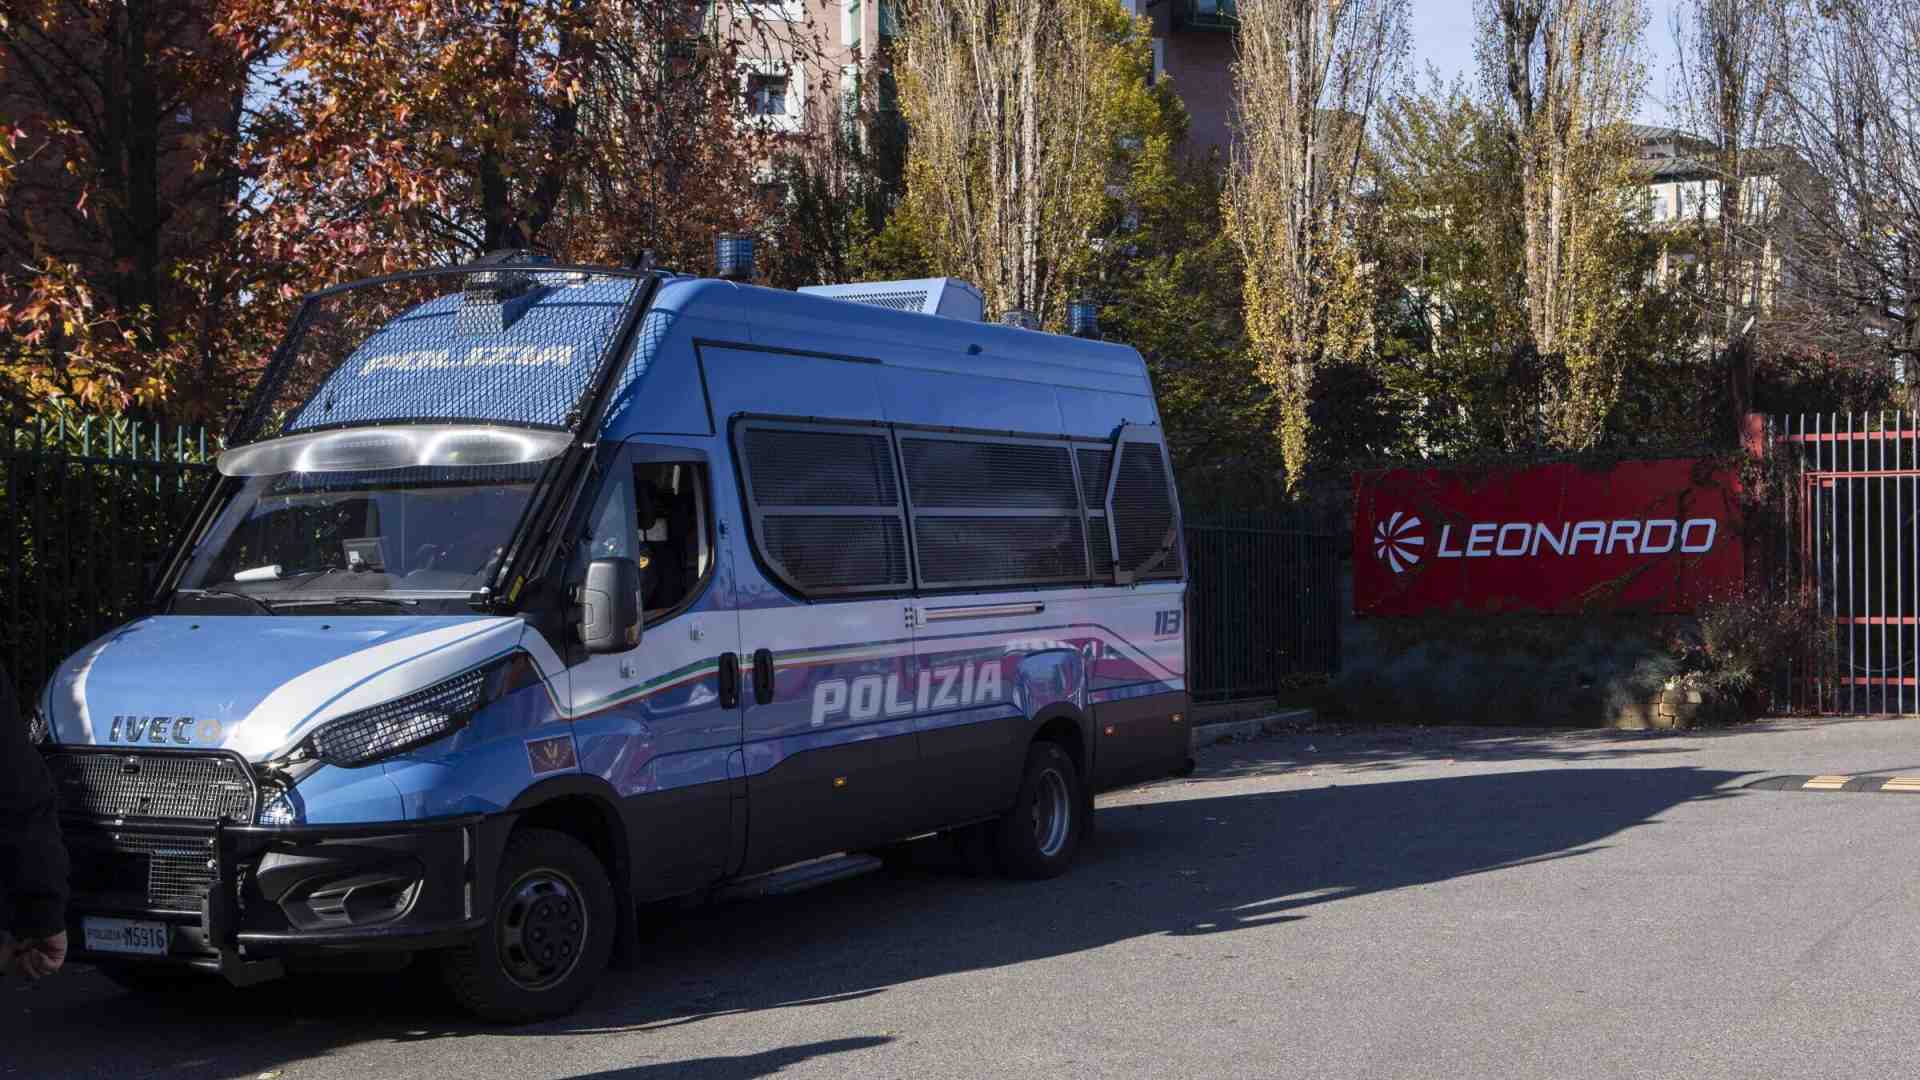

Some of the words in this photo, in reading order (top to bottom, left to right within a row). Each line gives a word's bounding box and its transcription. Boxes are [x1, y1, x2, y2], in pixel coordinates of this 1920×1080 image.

[1437, 517, 1717, 559] LEONARDO
[1153, 609, 1182, 636] 113
[811, 658, 1002, 728] POLIZIA
[109, 714, 222, 745] IVECO
